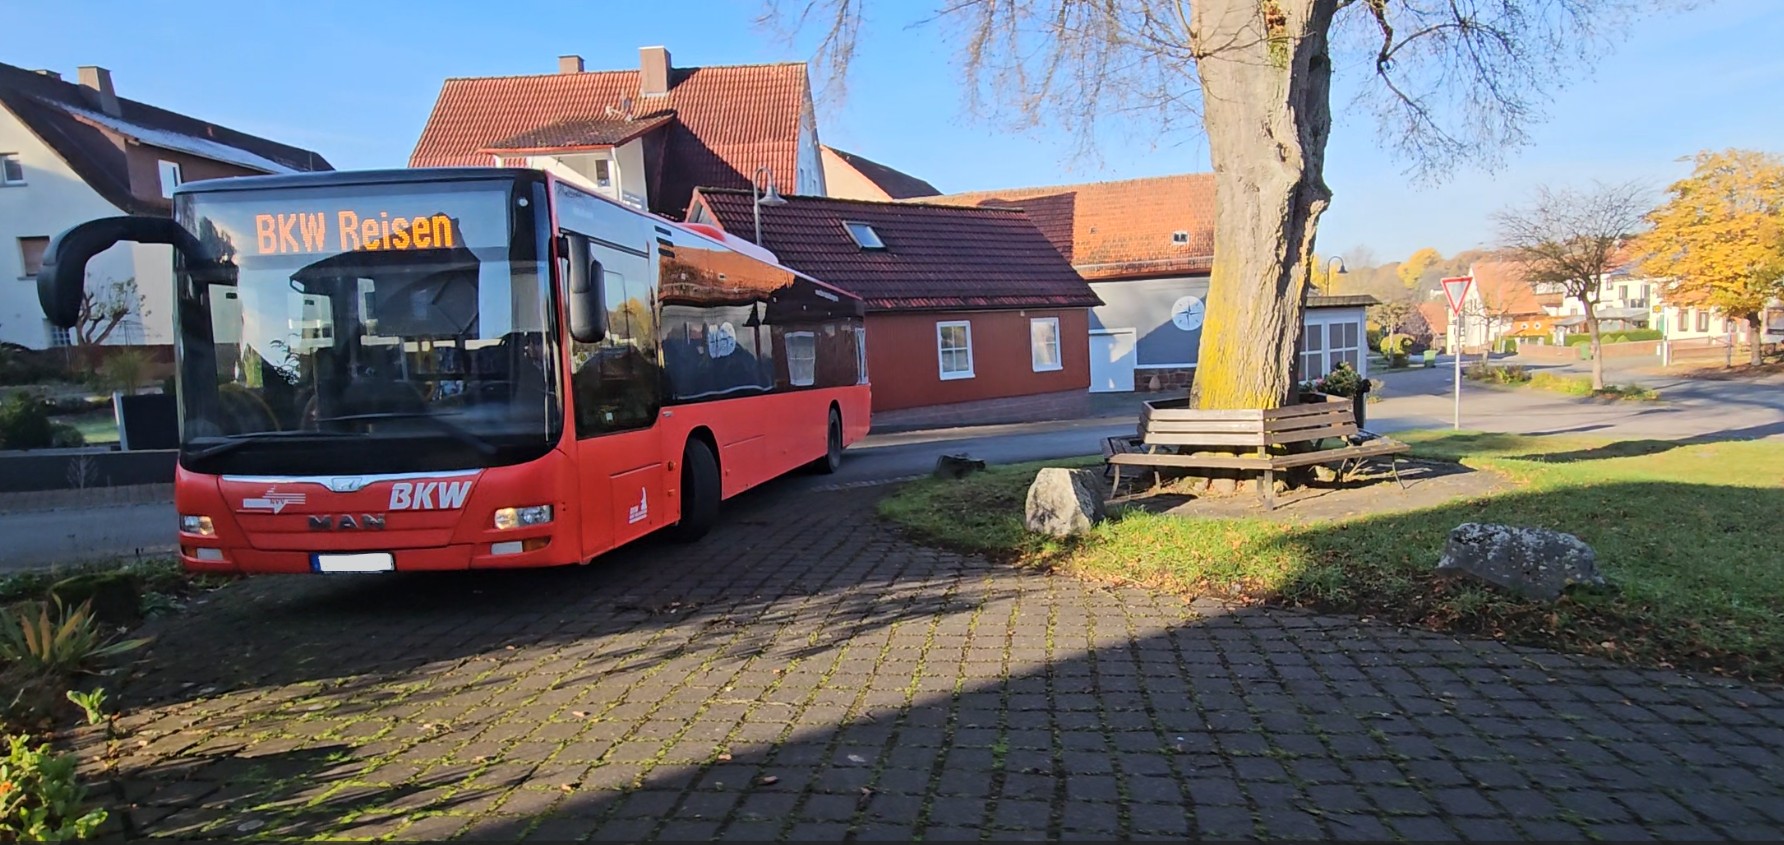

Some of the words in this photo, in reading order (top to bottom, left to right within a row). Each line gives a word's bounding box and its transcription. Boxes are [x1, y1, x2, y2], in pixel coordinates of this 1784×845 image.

[256, 212, 326, 254] BKW
[338, 210, 452, 251] Reisen
[389, 481, 472, 510] BKW
[308, 514, 386, 530] MAN
